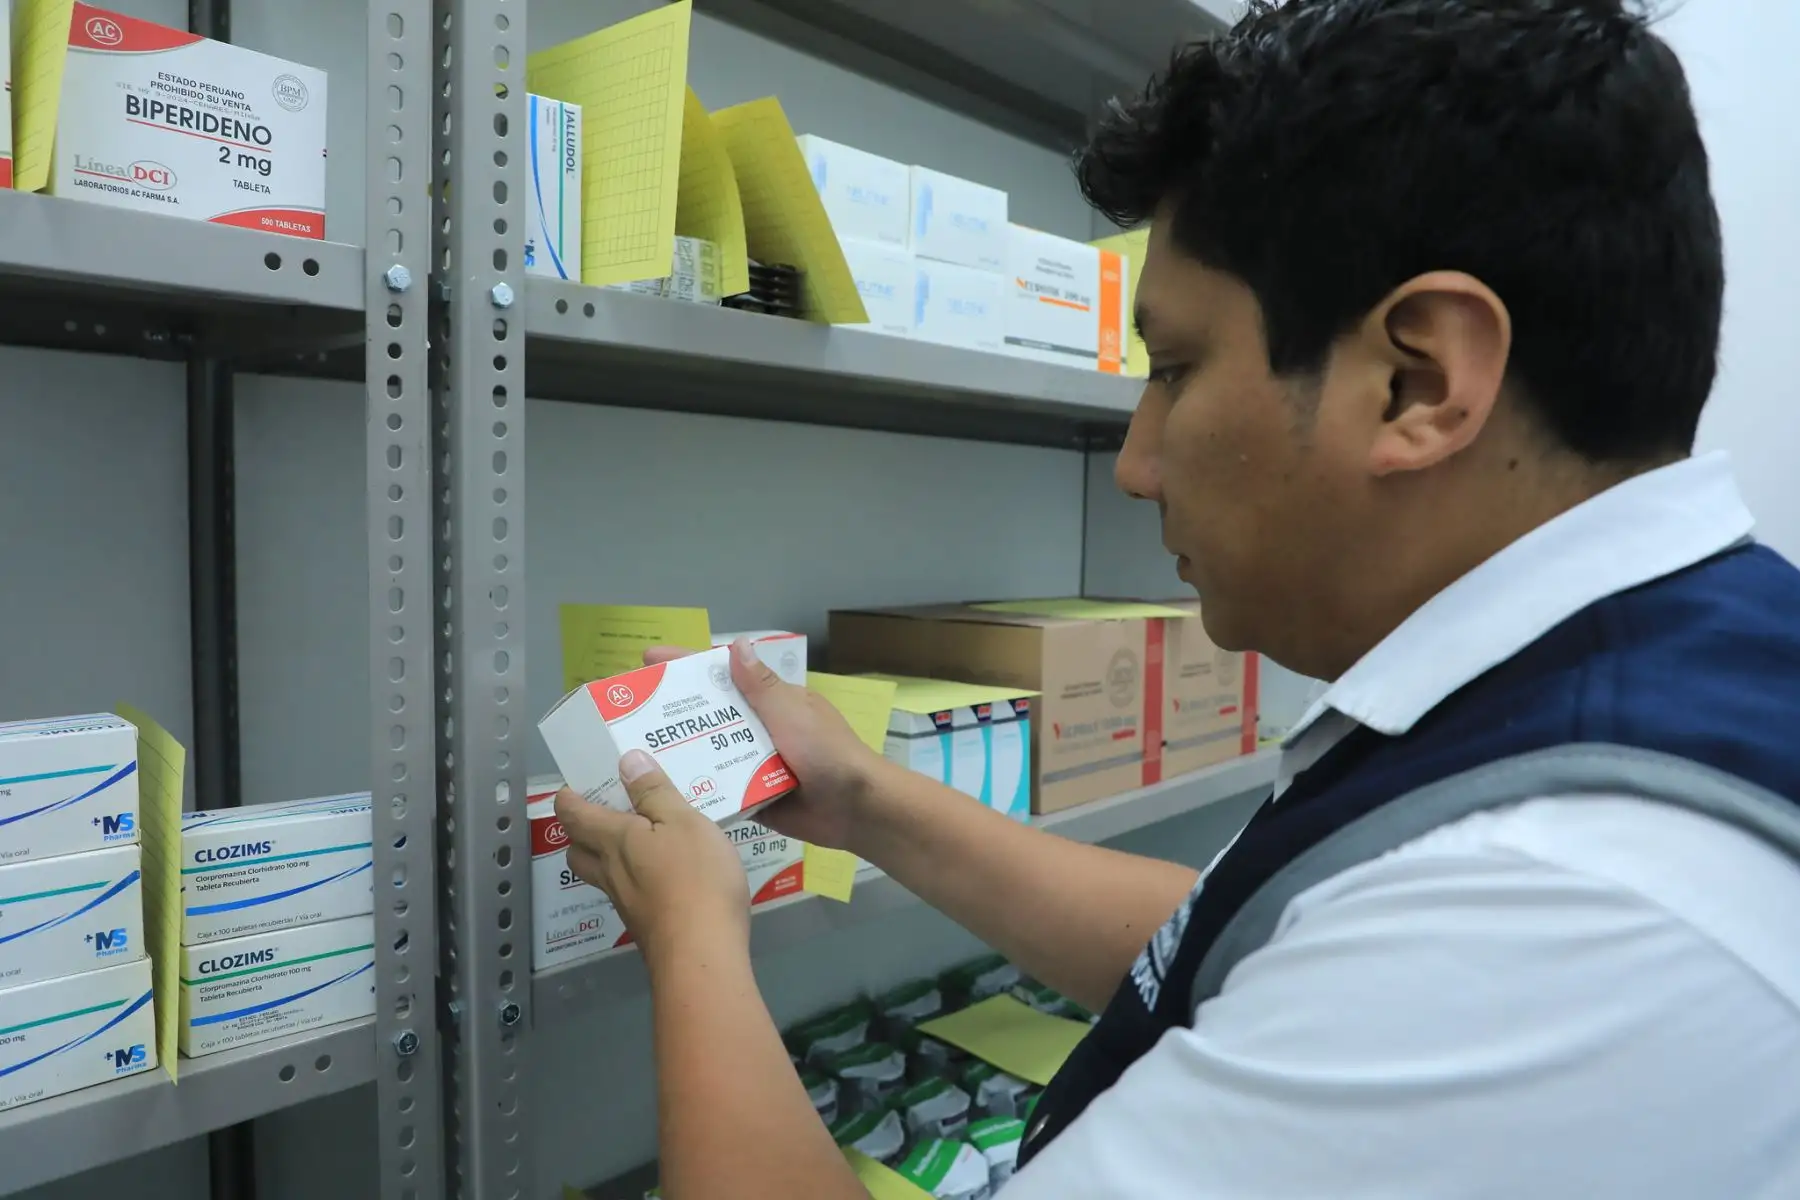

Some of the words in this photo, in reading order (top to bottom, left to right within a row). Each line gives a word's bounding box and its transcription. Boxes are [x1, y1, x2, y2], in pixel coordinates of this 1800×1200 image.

[92, 21, 116, 38] AC
[158, 71, 197, 88] ESTADO
[199, 82, 245, 100] PERUANO
[150, 80, 204, 101] PROHIBIDO
[206, 94, 220, 105] SU
[221, 99, 252, 113] VENTA
[126, 94, 272, 146] BIPERIDENO
[565, 109, 576, 175] JALLUDOL
[218, 146, 231, 164] 2
[237, 153, 272, 177] mg
[133, 165, 170, 186] DCI
[74, 178, 129, 195] LABORATORIOS
[131, 189, 141, 197] AC
[142, 191, 166, 202] FARMA
[232, 179, 271, 195] TABLETA
[275, 219, 311, 233] TABLETAS
[612, 687, 629, 701] AC
[662, 699, 682, 711] ESTADO
[645, 705, 743, 749] SERTRALINA
[710, 733, 729, 751] 50
[730, 727, 755, 743] mg
[714, 758, 735, 772] TABLETA
[691, 780, 714, 796] DCI
[103, 832, 136, 842] Pharma
[550, 825, 566, 839] AC
[14, 848, 30, 857] oral
[194, 840, 272, 864] CLOZIMS
[752, 842, 766, 856] 50
[769, 838, 787, 852] mg
[195, 869, 247, 883] Clorpromazina
[247, 863, 286, 876] Clorhidrato
[286, 861, 298, 869] 100
[299, 860, 310, 868] mg
[196, 881, 222, 892] Tableta
[222, 877, 260, 888] Recubierta
[218, 926, 231, 936] 100
[579, 918, 600, 933] DCI
[96, 947, 128, 958] Pharma
[198, 948, 275, 974] CLOZIMS
[199, 978, 250, 994] Clorpromazina
[250, 971, 289, 984] Clorhidrato
[288, 967, 301, 975] 100
[301, 965, 312, 973] mg
[200, 993, 225, 1003] Tableta
[226, 984, 263, 997] Recubierta
[12, 1034, 26, 1042] mg
[221, 1036, 234, 1045] 100
[115, 1062, 147, 1074] Pharma
